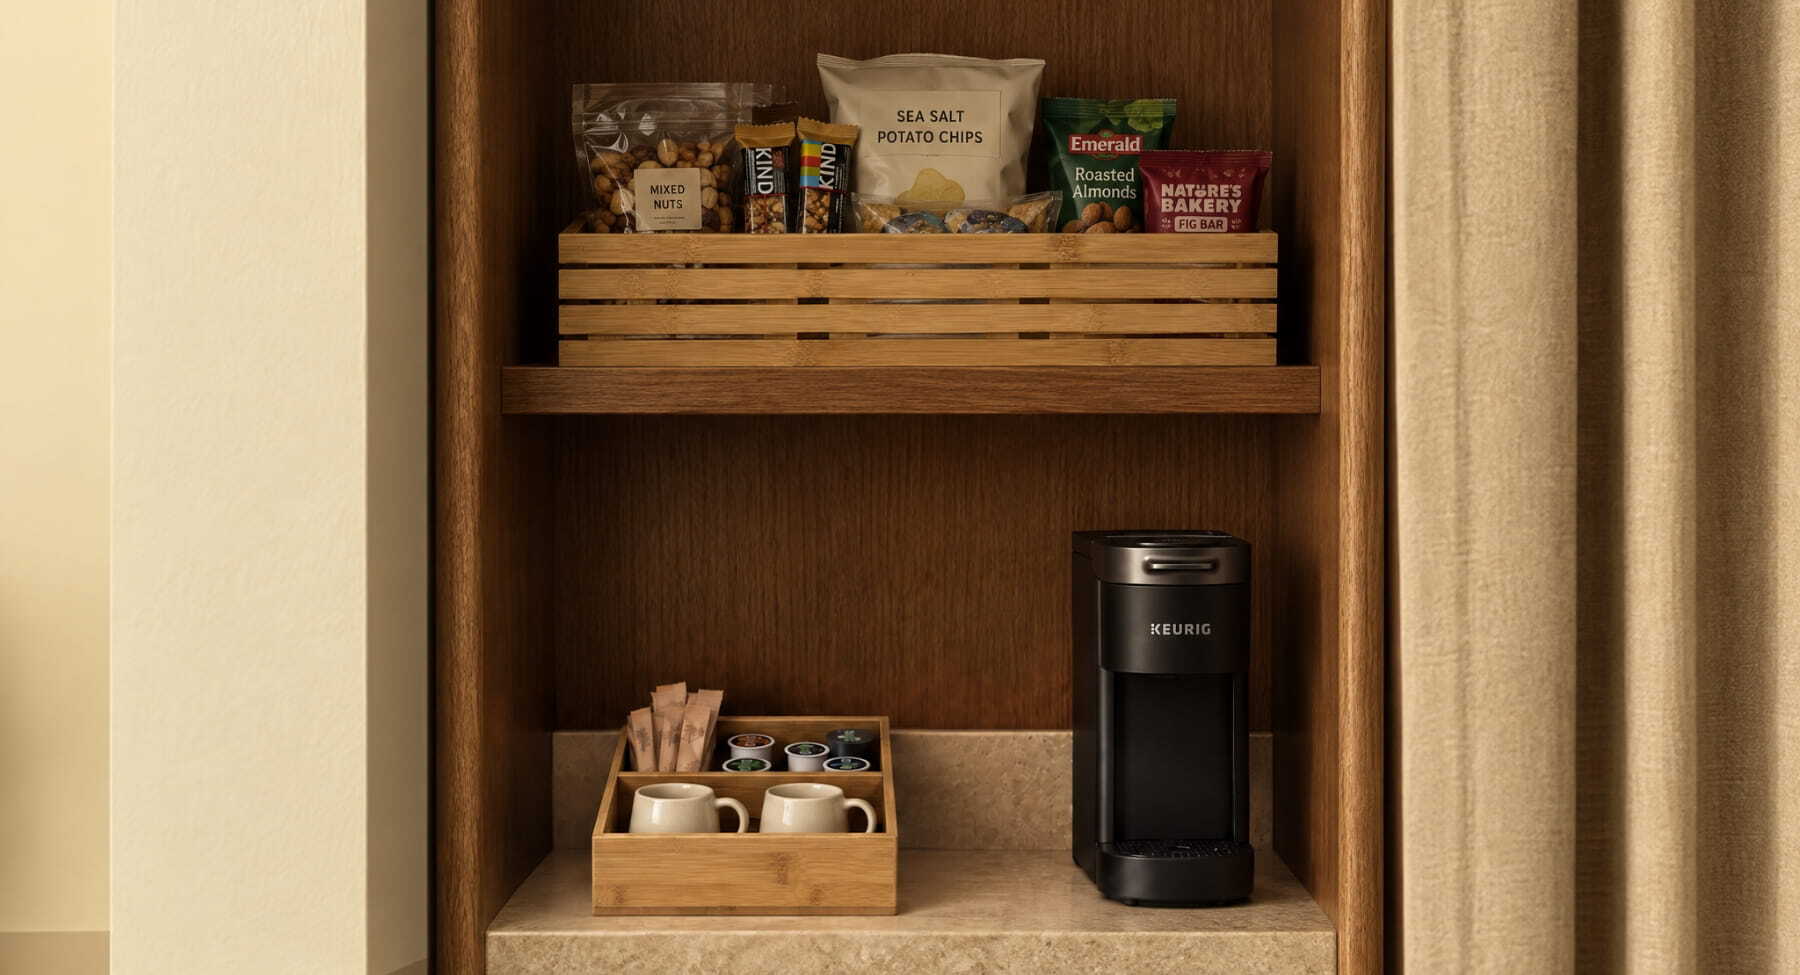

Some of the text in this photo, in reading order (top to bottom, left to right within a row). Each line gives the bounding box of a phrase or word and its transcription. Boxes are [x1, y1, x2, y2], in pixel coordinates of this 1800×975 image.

[897, 110, 965, 123] SEA SALT
[878, 130, 983, 144] POTATO CHIPS
[1071, 136, 1141, 152] Emerald
[755, 147, 774, 194] KIND
[818, 143, 836, 190] KIND
[1075, 167, 1135, 182] Roasted
[650, 184, 685, 195] MIXED
[1072, 184, 1137, 199] Almonds
[1161, 183, 1242, 198] NATURE'S
[654, 199, 683, 209] NUTS
[1161, 198, 1242, 213] BAKERY
[1179, 219, 1224, 230] FIG BAR
[1150, 623, 1211, 636] KEURIG
